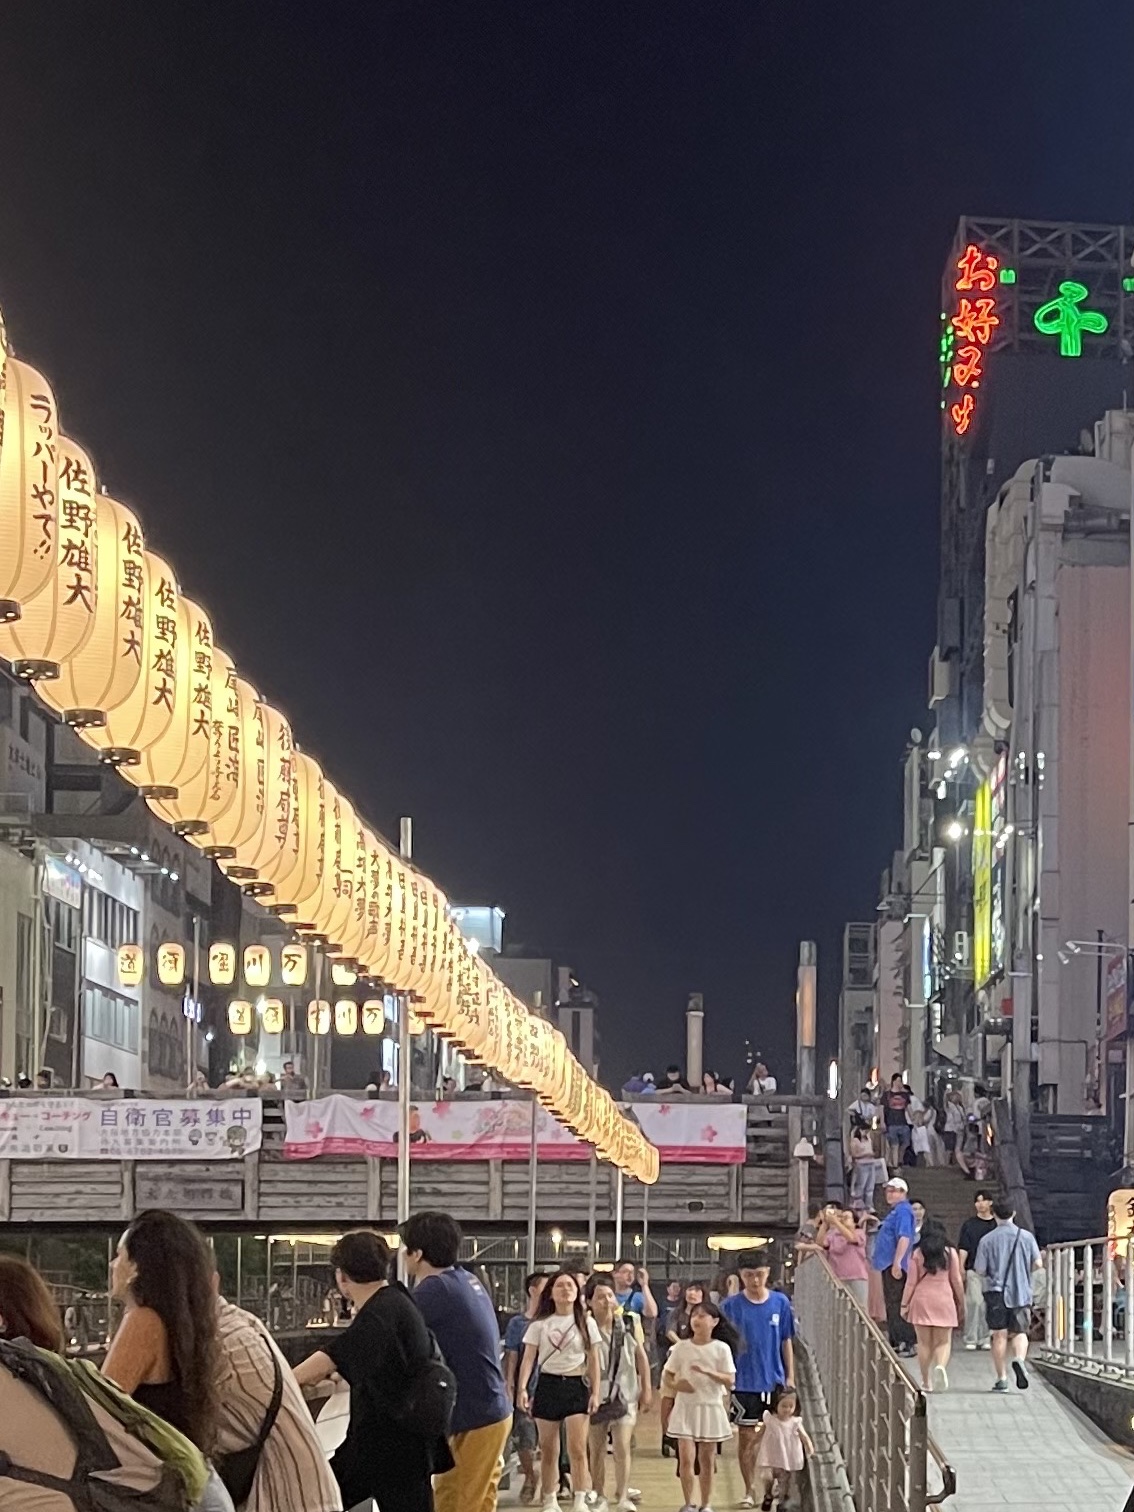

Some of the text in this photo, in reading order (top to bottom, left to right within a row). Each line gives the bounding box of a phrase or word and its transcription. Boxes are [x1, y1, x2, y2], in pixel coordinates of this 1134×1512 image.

[58, 456, 93, 614] 佐野雄大
[120, 521, 143, 667] 佐野雄大
[152, 577, 178, 715] 佐野雄大
[192, 621, 213, 740] 佐野雄大
[100, 1106, 252, 1128] 自衛官募集中
